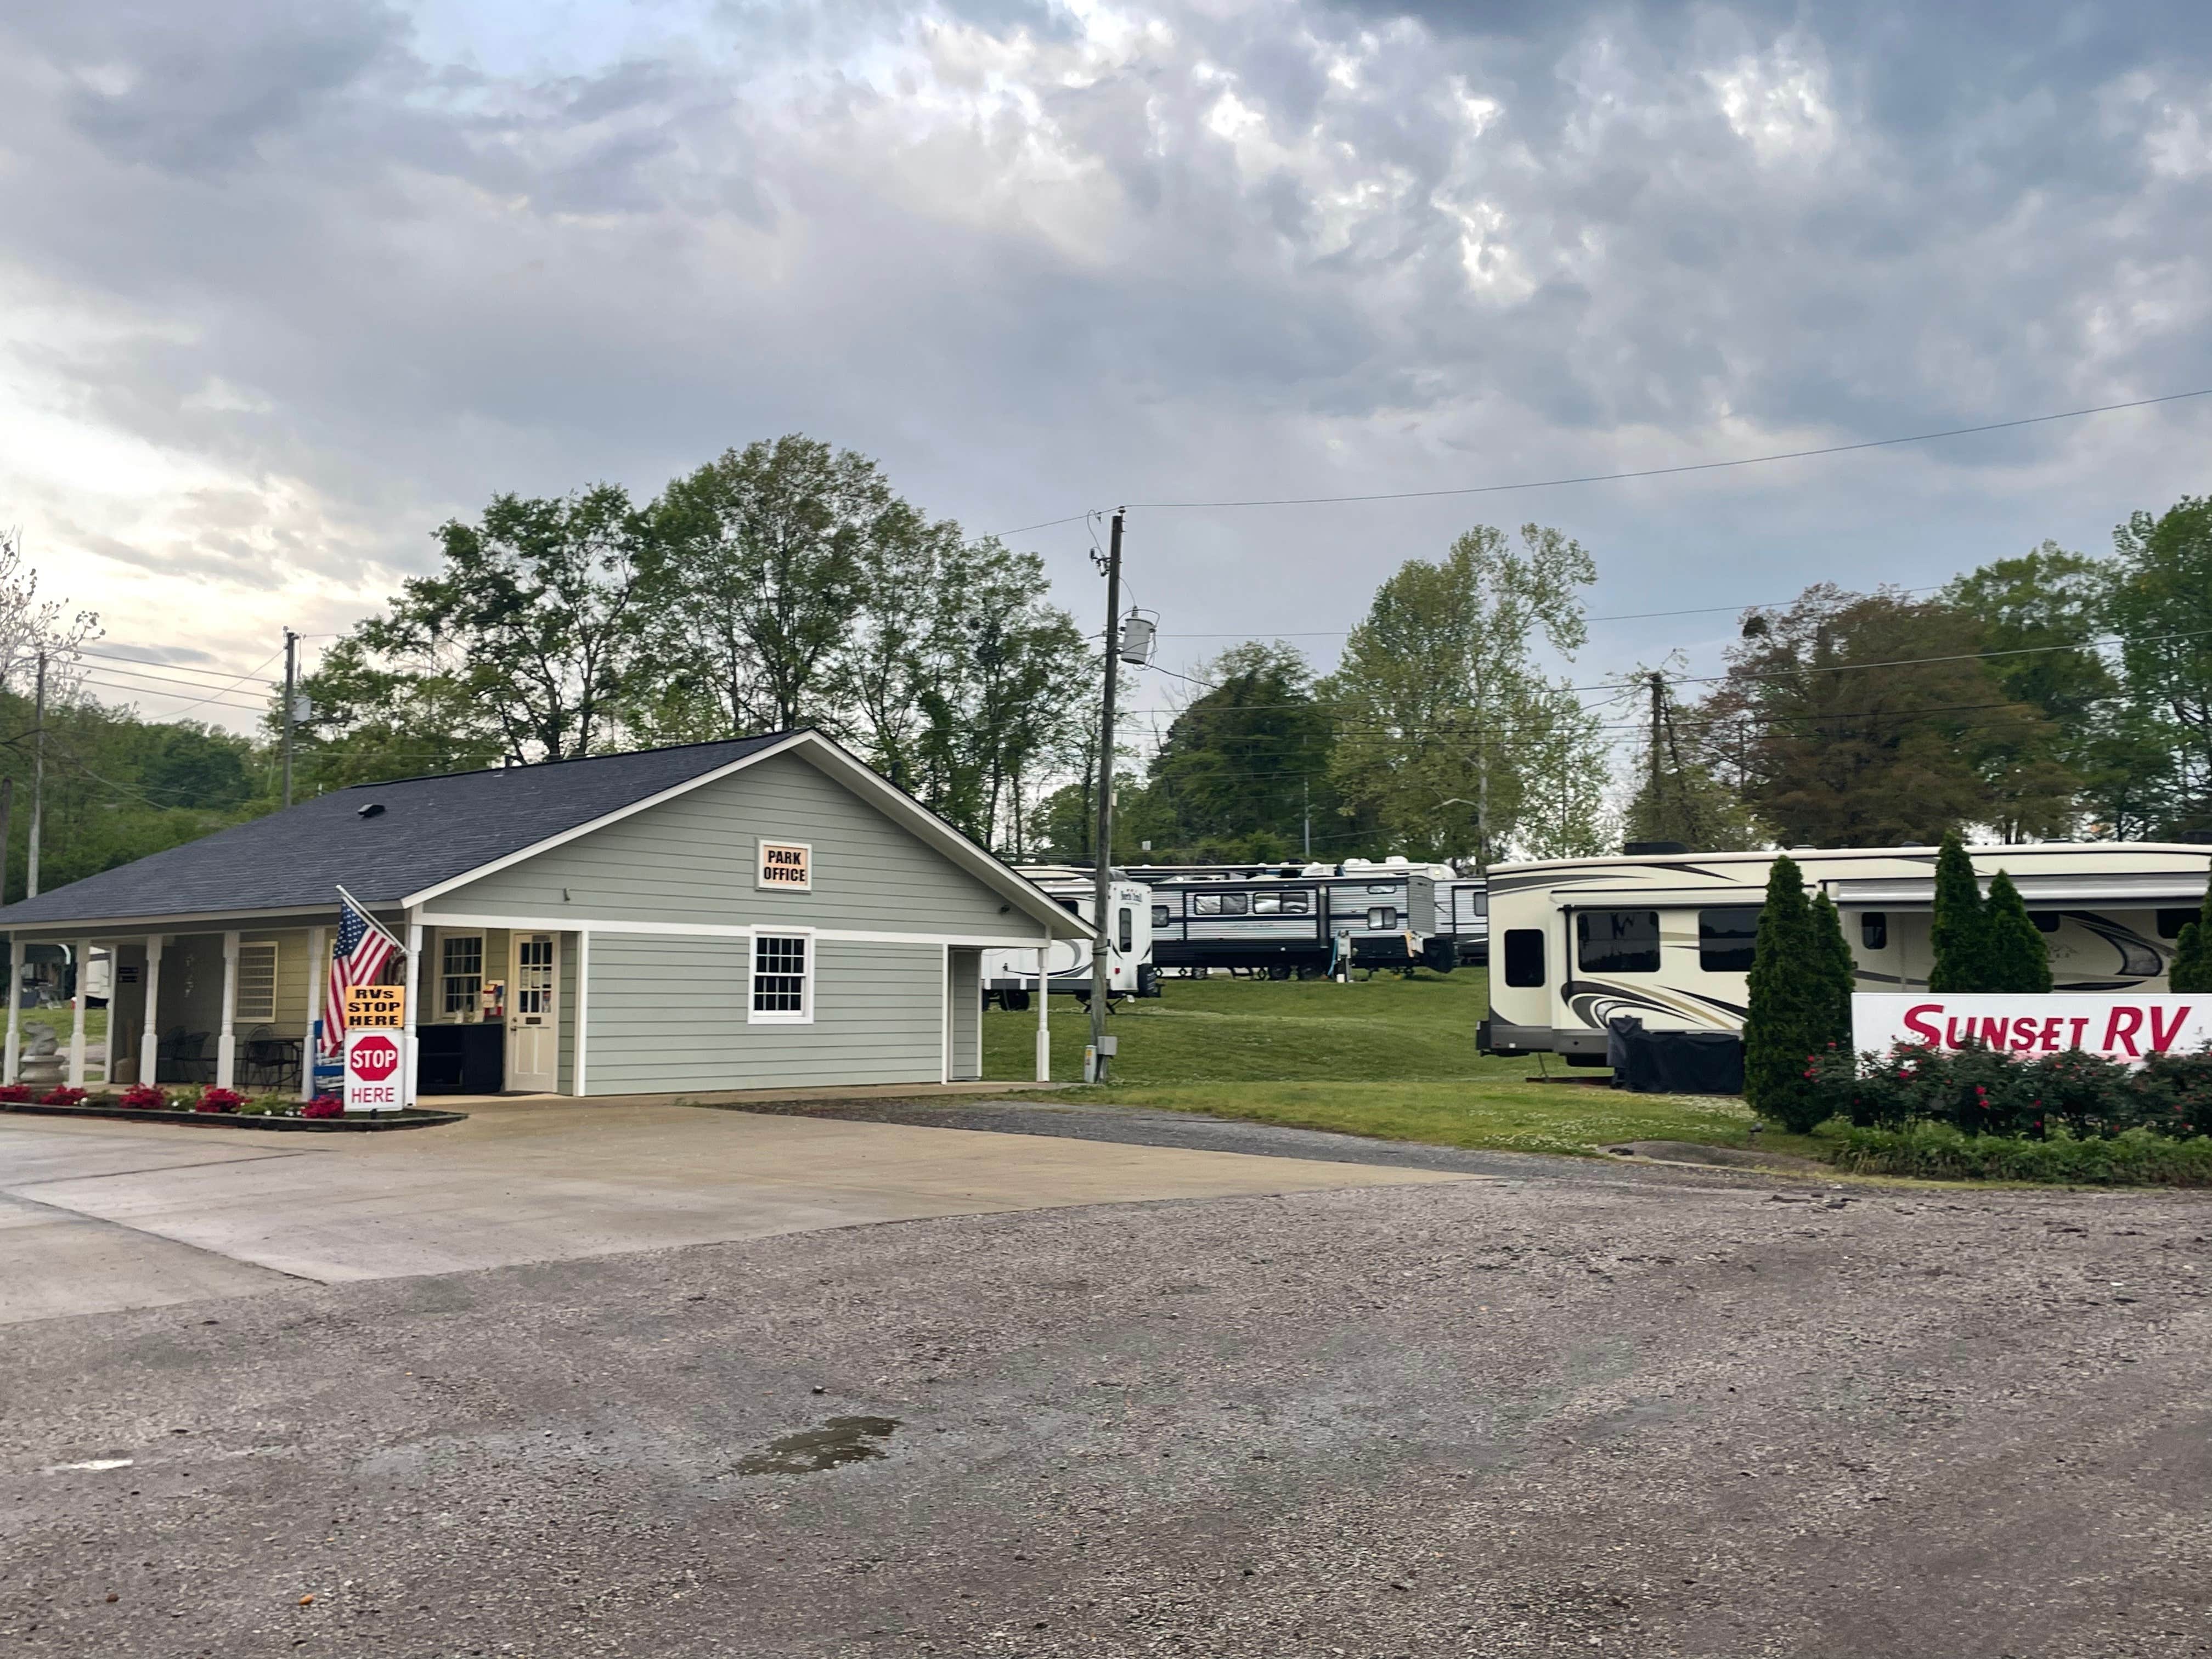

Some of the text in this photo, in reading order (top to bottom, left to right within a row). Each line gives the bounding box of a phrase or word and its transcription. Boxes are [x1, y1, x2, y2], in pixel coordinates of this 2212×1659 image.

[768, 850, 801, 865] PARK
[764, 866, 805, 882] OFFICE
[354, 989, 394, 998] RVs
[348, 1002, 400, 1012] STOP
[349, 1015, 399, 1026] HERE
[2102, 1006, 2192, 1057] RV
[352, 1049, 397, 1068] STOP
[351, 1087, 394, 1103] HERE
